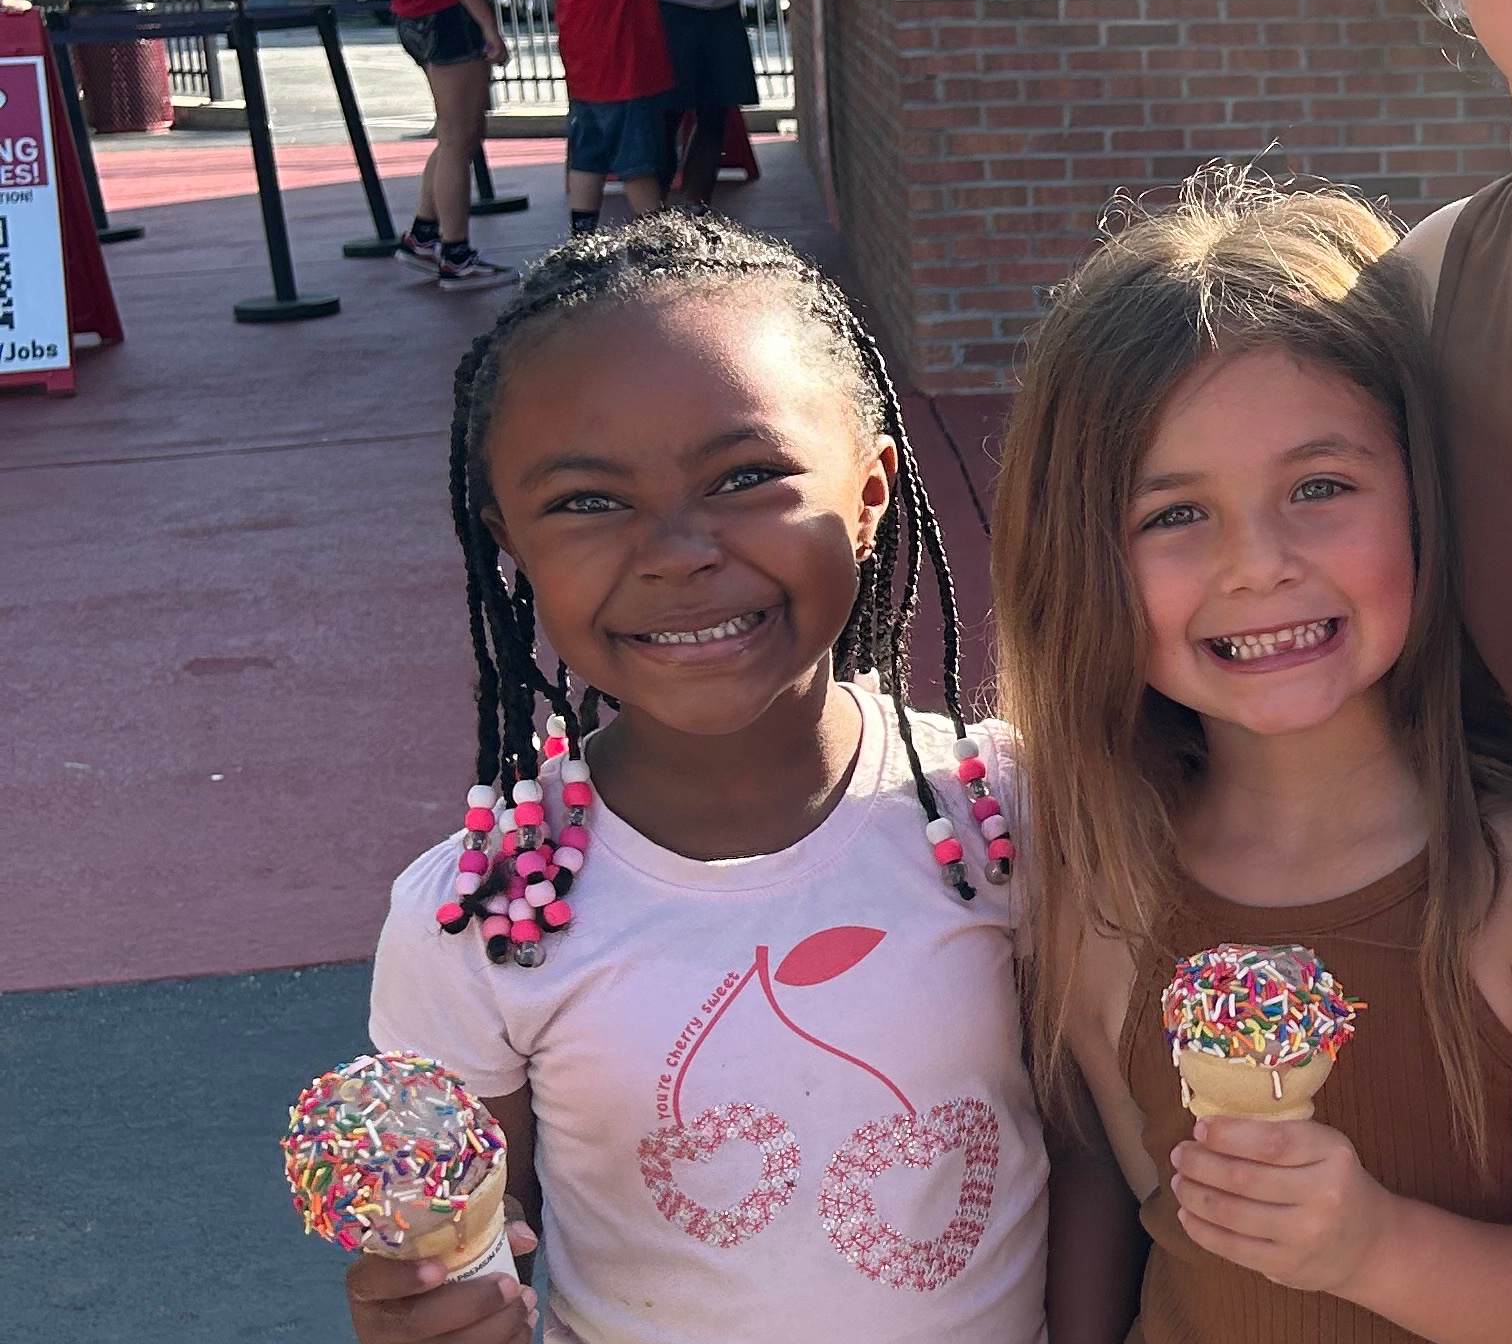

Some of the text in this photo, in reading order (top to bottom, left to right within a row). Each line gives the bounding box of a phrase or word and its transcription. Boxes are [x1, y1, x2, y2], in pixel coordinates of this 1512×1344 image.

[0, 137, 38, 163] NG
[656, 971, 740, 1120] you're cherry sweet
